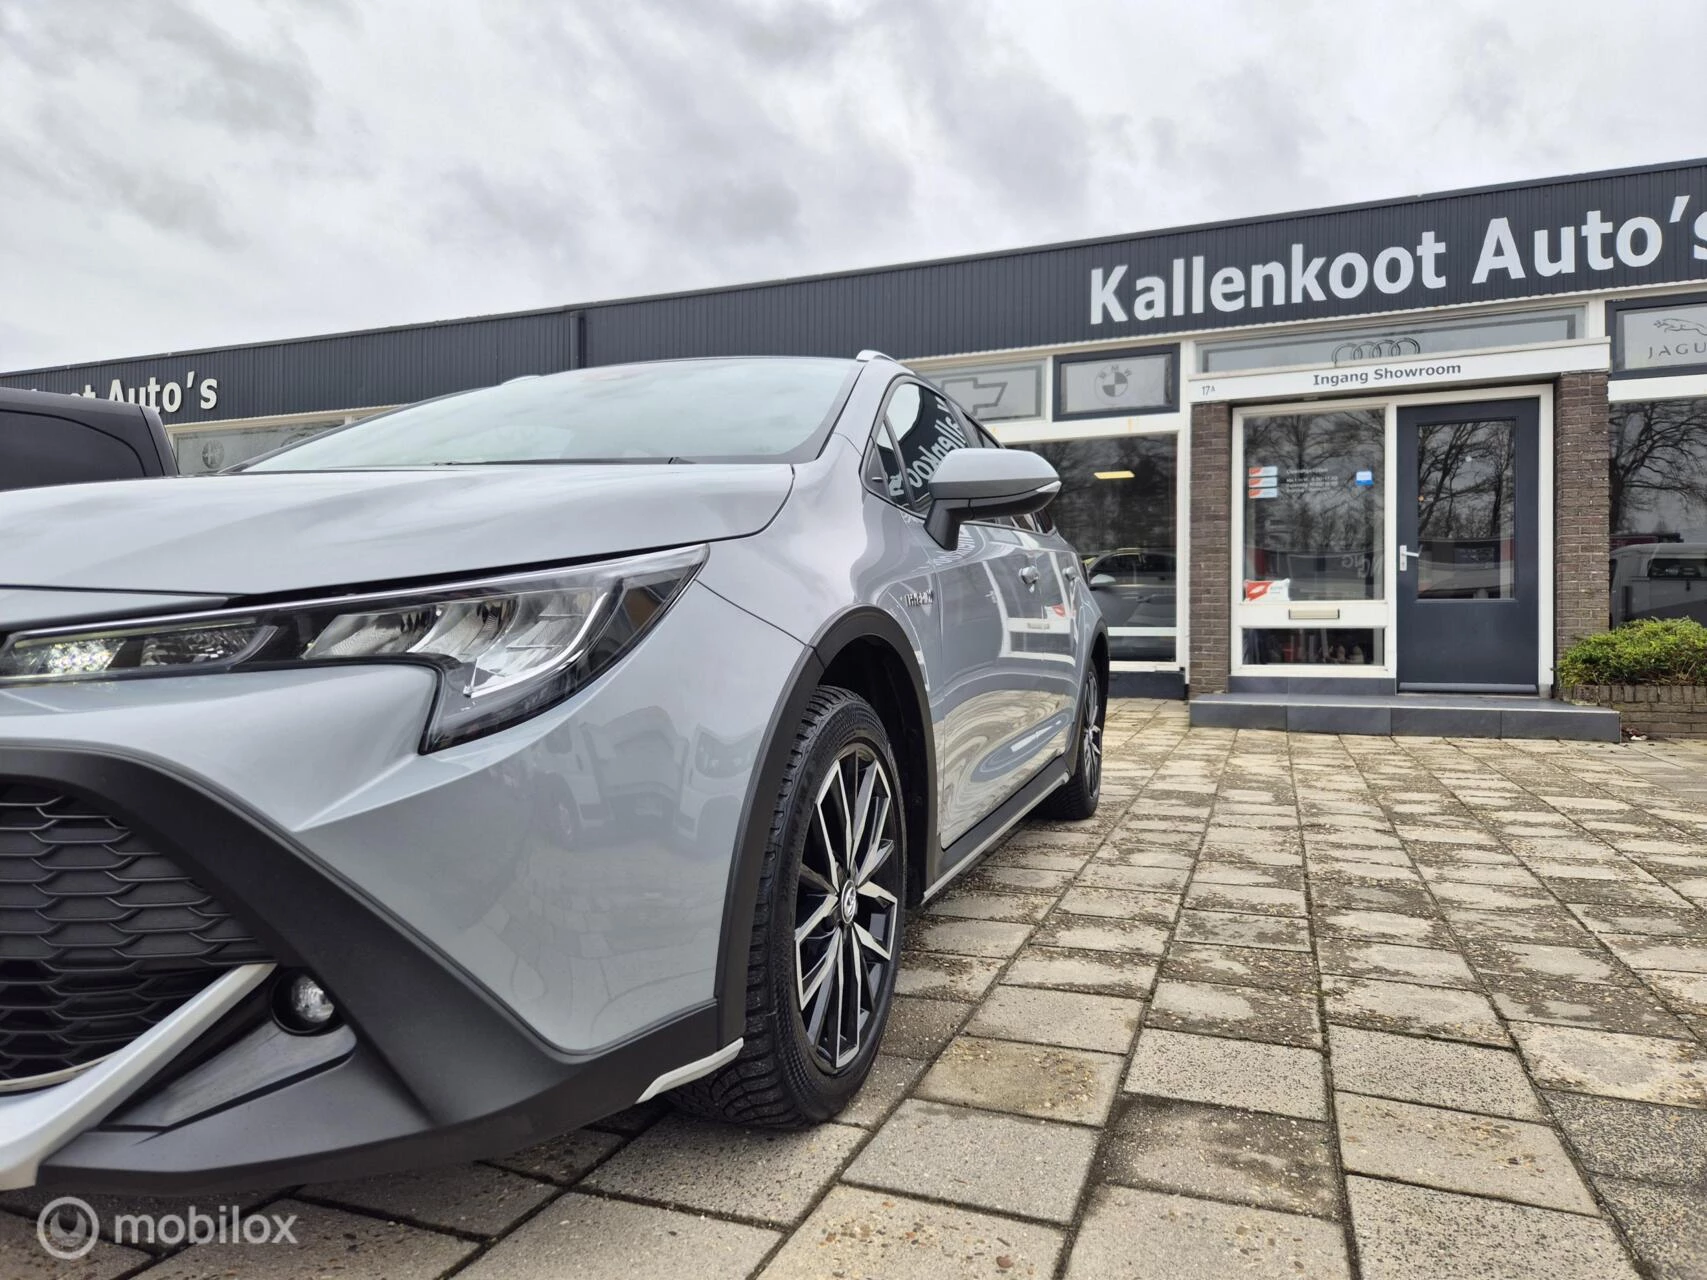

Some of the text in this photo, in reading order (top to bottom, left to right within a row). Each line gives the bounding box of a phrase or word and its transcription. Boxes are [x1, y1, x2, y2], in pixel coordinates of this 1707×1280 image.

[1090, 231, 1446, 325] Kallenkoot
[1648, 342, 1707, 359] JAGU
[1313, 364, 1461, 386] Ingang Showroom
